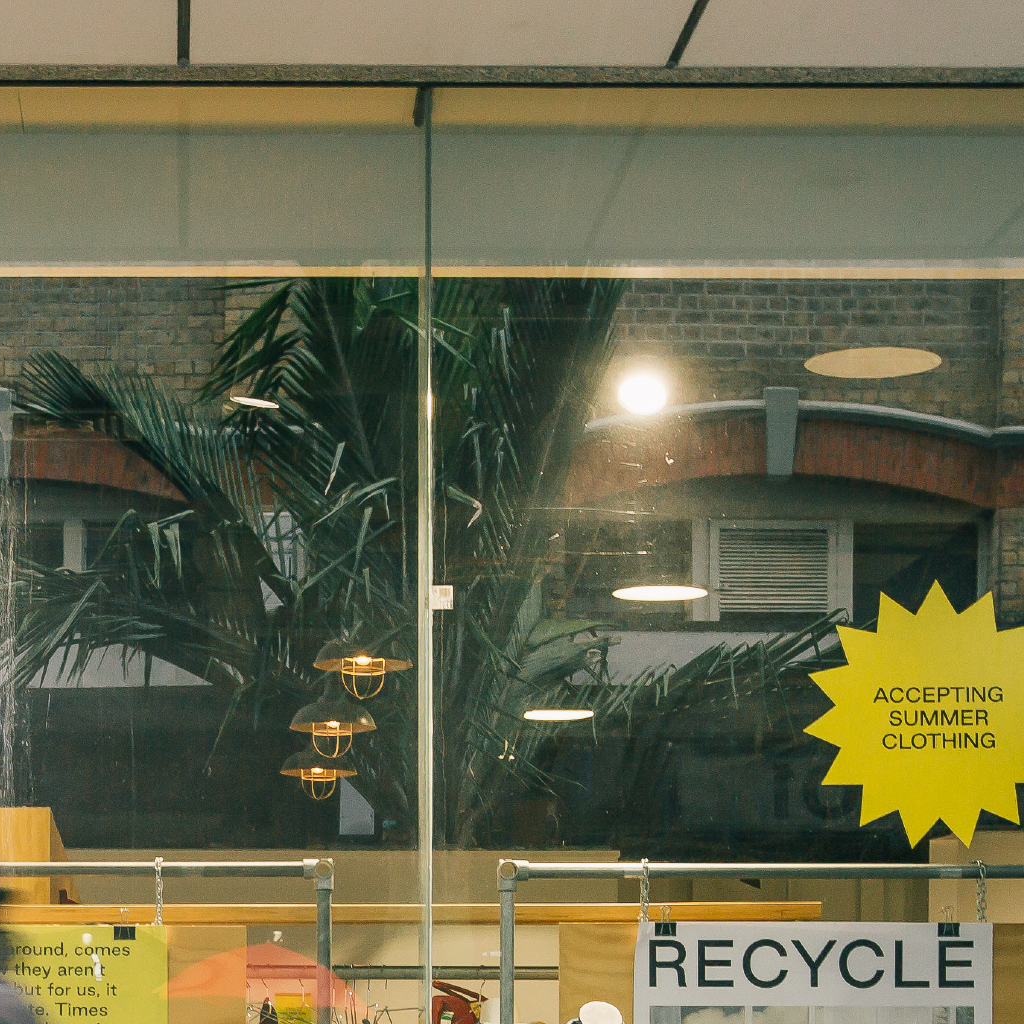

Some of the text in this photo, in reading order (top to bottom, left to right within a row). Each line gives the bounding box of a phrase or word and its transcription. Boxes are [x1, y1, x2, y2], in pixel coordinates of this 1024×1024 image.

[873, 685, 1004, 704] ACCEPTING
[889, 708, 989, 727] SUMMER
[881, 732, 996, 750] CLOTHING
[13, 942, 68, 958] round,
[74, 946, 131, 957] comes
[14, 961, 52, 980] they
[57, 964, 106, 977] arent
[648, 938, 975, 989] RECYCLE
[47, 982, 71, 997] for
[76, 985, 101, 998] us,
[106, 982, 118, 997] it
[54, 1002, 108, 1017] Times
